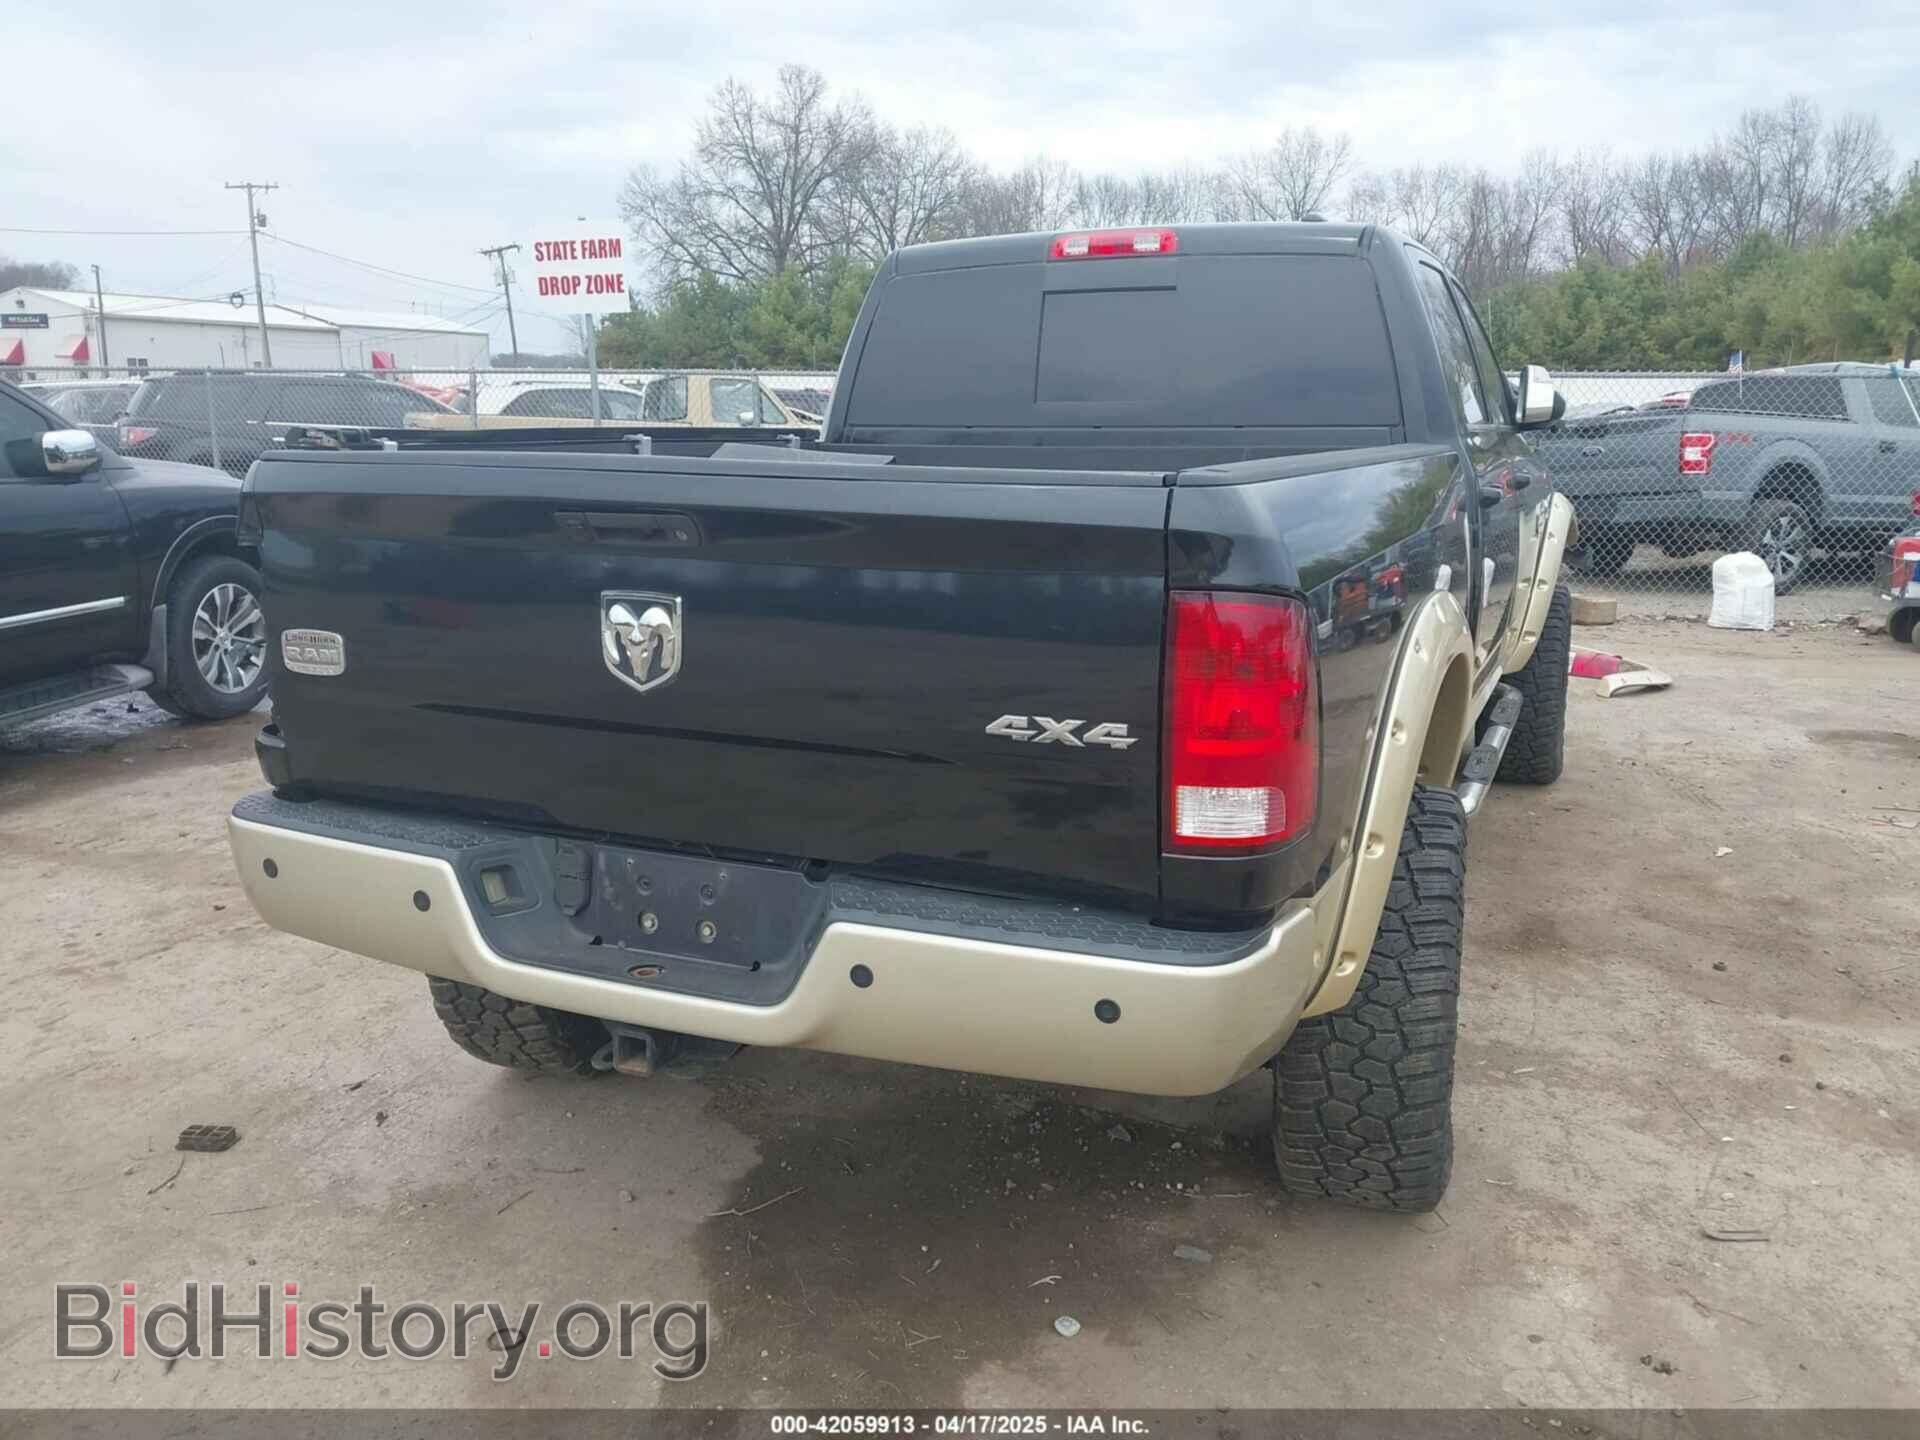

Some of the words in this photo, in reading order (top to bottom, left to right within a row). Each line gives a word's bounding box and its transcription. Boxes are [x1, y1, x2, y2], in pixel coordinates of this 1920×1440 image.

[534, 240, 578, 261] STATE
[581, 238, 622, 259] FARM
[537, 275, 581, 295] DROP
[585, 273, 625, 294] ZONE
